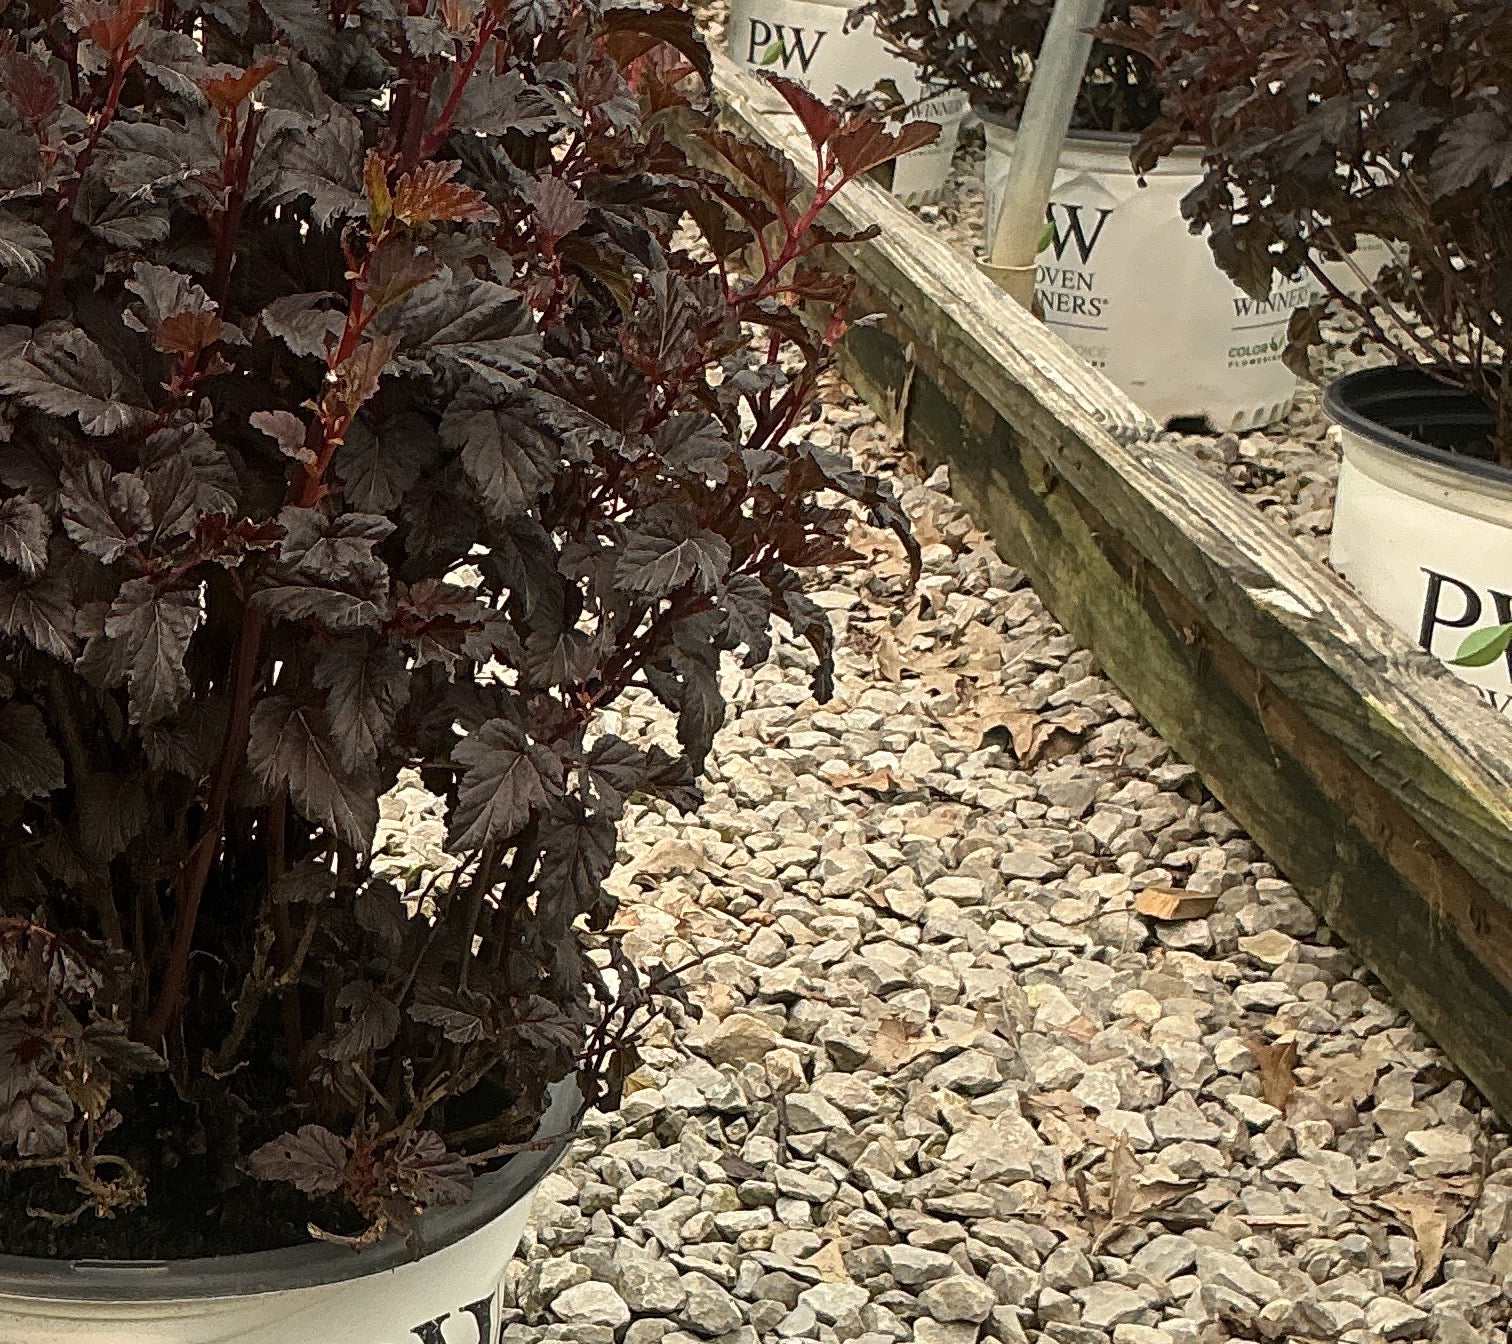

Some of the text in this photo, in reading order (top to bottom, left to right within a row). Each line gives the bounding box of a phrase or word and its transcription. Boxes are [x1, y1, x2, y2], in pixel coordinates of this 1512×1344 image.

[747, 17, 828, 73] PW
[1045, 203, 1114, 265] W
[1036, 264, 1095, 292] OVEN
[1035, 288, 1109, 317] NERS
[1232, 286, 1308, 317] WINNER
[1419, 567, 1512, 686] P
